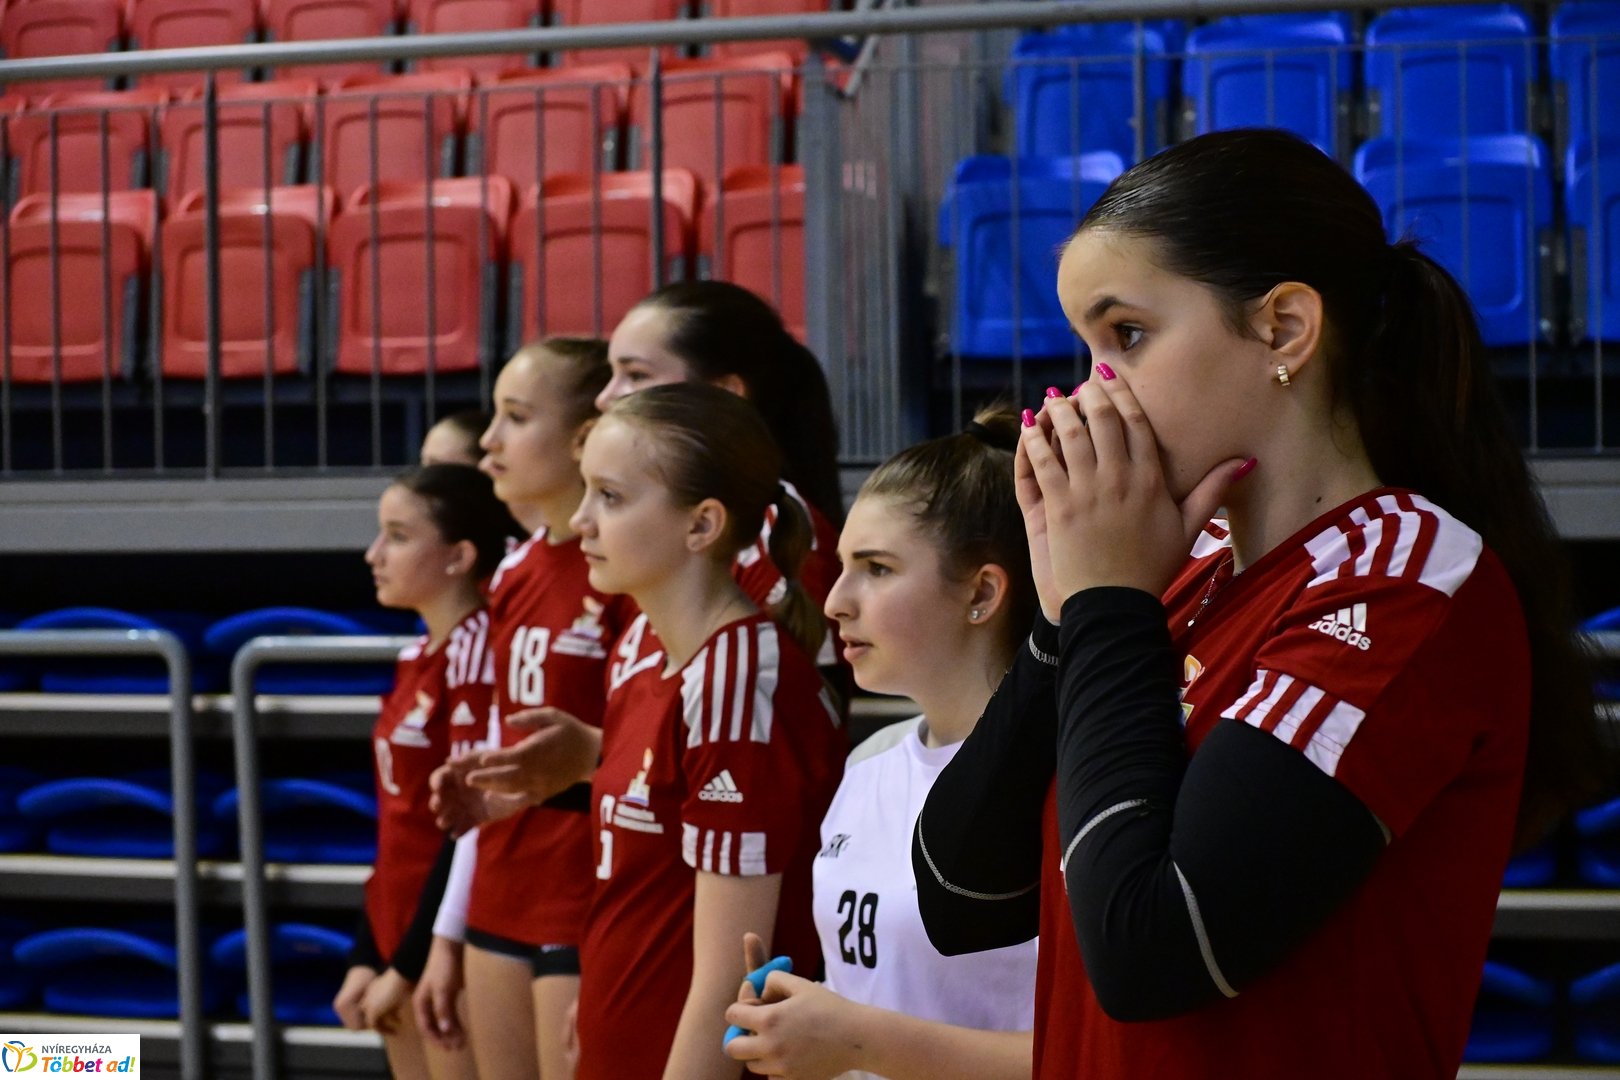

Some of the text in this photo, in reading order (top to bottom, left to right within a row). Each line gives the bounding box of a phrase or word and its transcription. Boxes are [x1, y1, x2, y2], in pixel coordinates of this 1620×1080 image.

[1307, 619, 1372, 651] adidas
[508, 625, 551, 706] 18
[697, 789, 744, 803] adidas
[837, 889, 879, 969] 28
